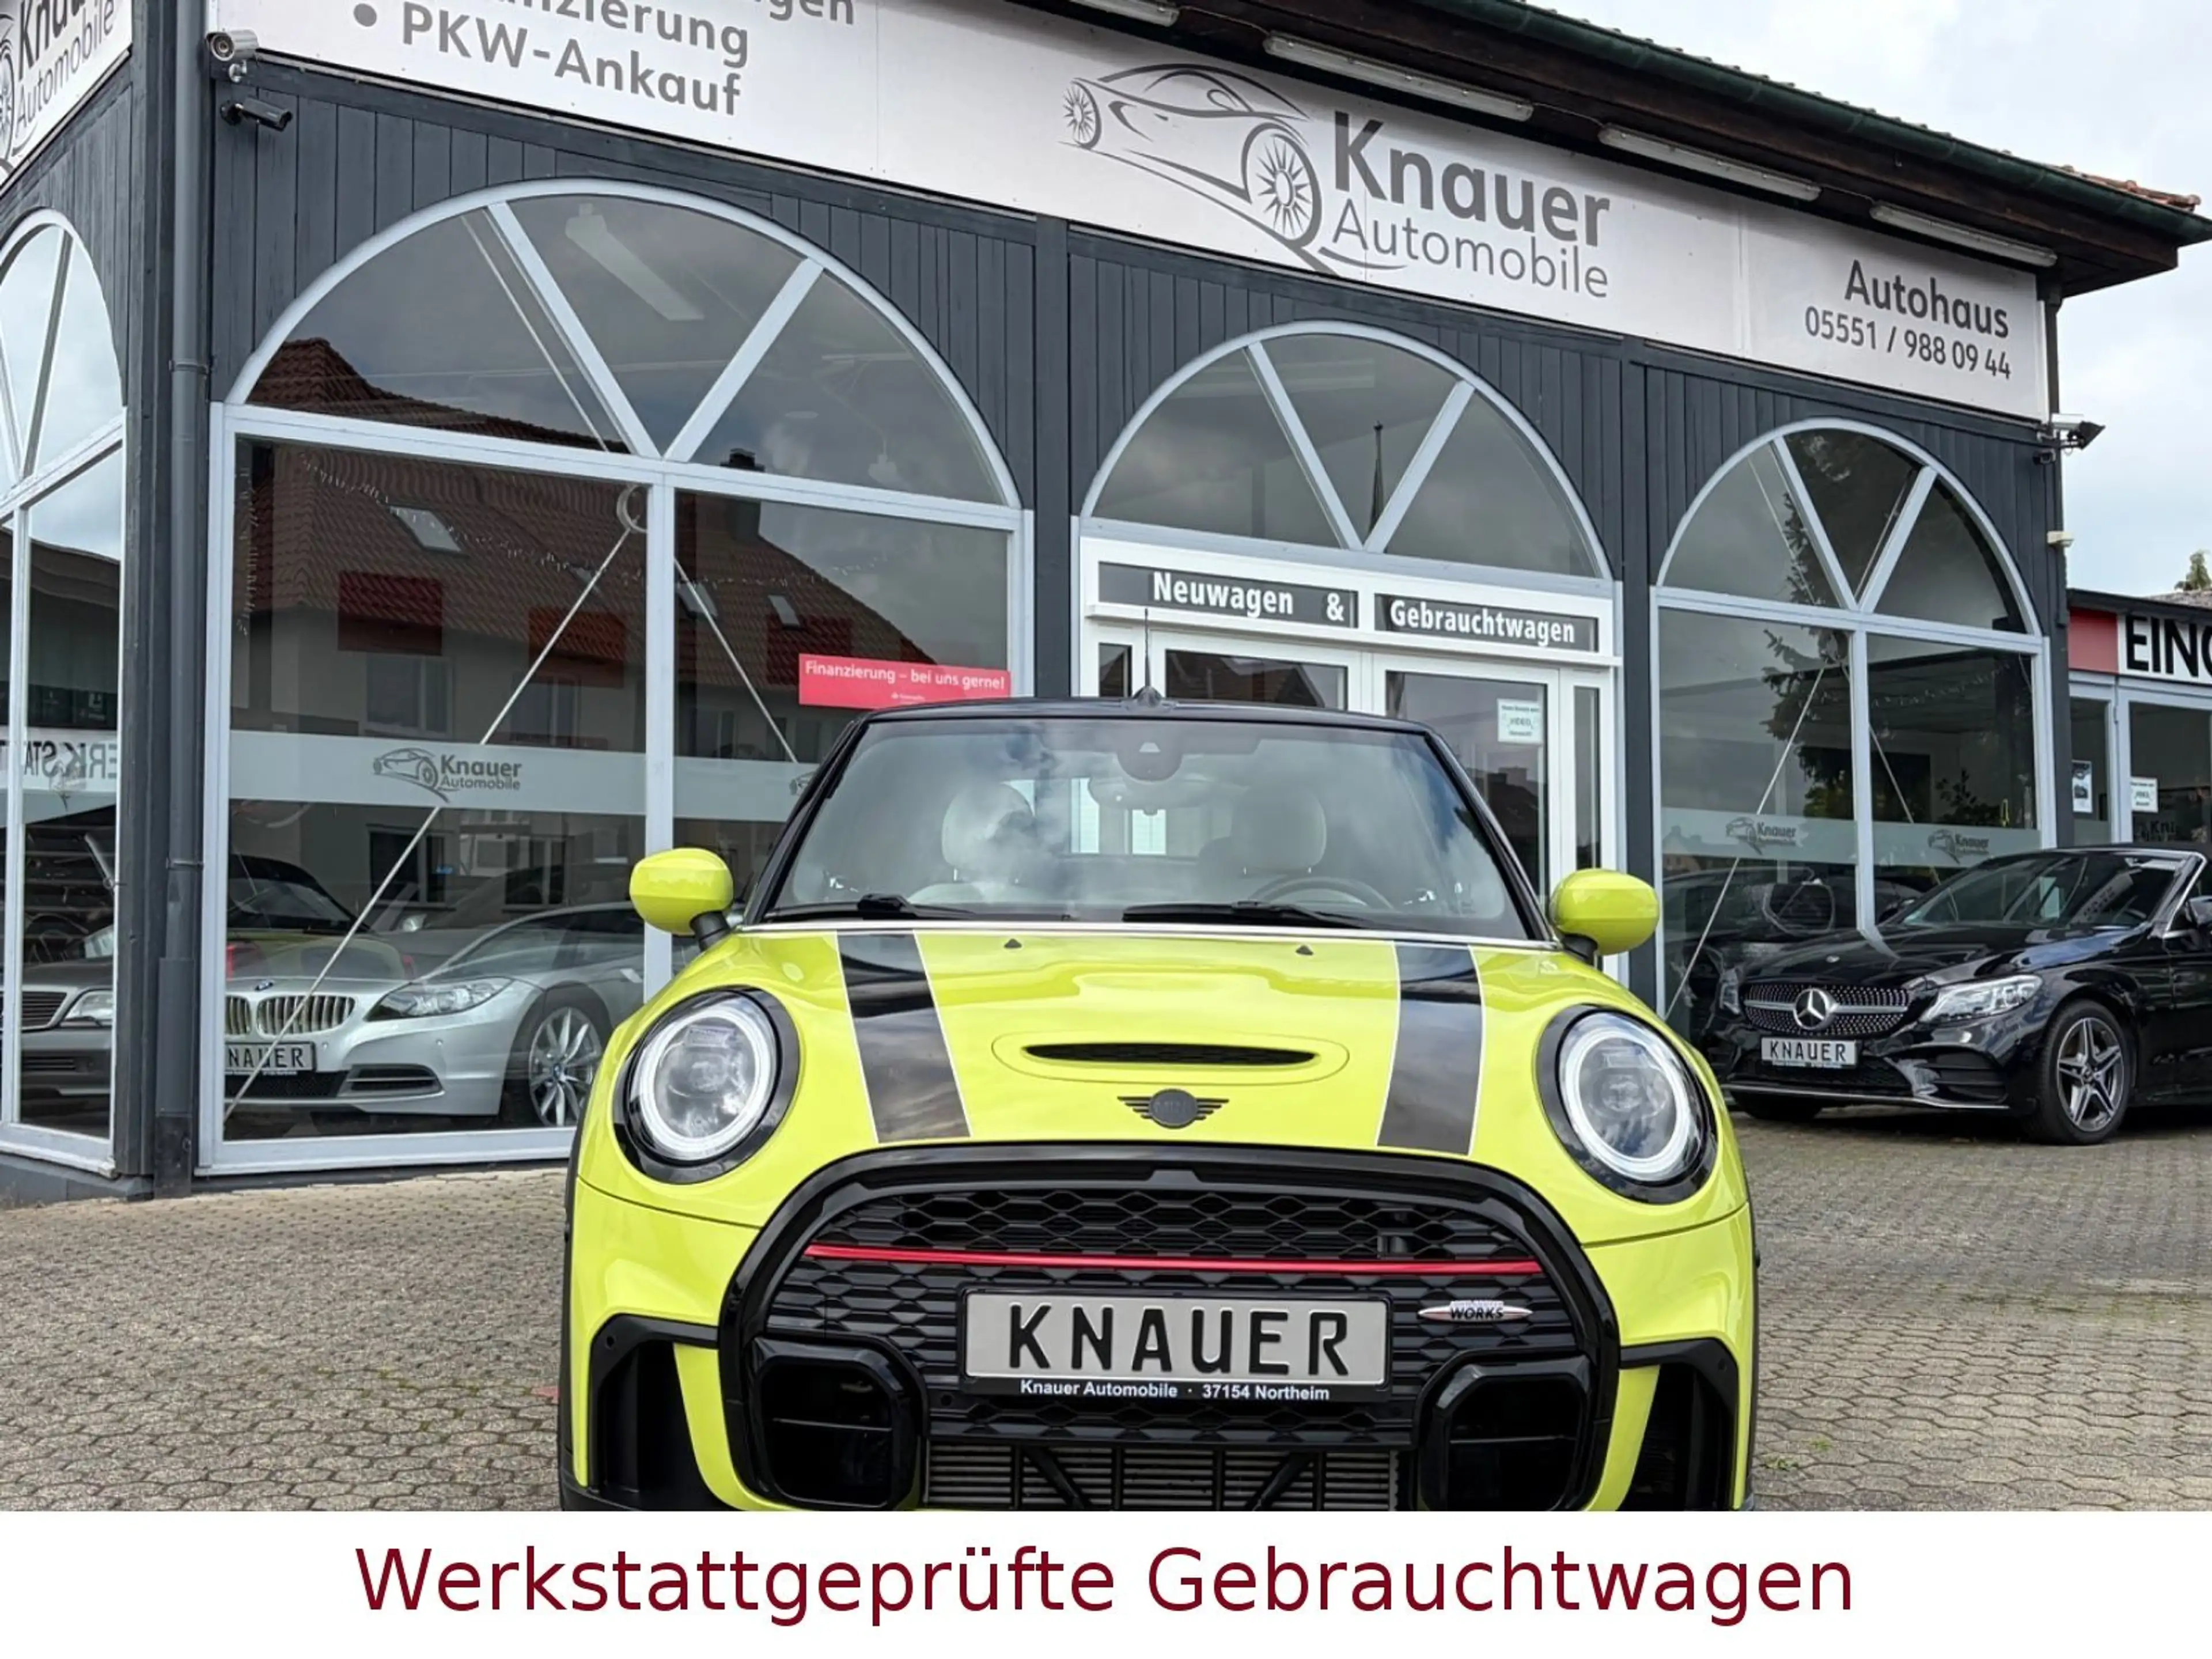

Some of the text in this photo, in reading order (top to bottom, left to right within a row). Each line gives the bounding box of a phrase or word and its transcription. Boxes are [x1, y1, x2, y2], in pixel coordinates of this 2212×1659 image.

[15, 0, 114, 139] Automobile
[403, 2, 741, 116] PKW-Ankauf
[1335, 111, 1610, 247] Knauer
[1332, 198, 1608, 298] Automobile
[1844, 259, 2009, 338] Autohaus
[1805, 306, 2011, 380] 05551 / 988 09 44
[1153, 571, 1344, 622] Neuwagen &
[1390, 600, 1575, 646] Gebrauchtwagen
[805, 660, 896, 684] Finanzierung
[911, 669, 932, 684] bei
[935, 673, 959, 685] uns
[963, 675, 1005, 691] gerne!
[440, 775, 521, 790] Automobile
[441, 754, 522, 777] Knauer
[229, 1047, 304, 1067] NAUER
[1770, 1041, 1846, 1062] KNAUER
[1450, 1306, 1503, 1319] WORKS
[1009, 1303, 1349, 1376] KNAUER
[1020, 1380, 1330, 1400] Knauer Automobile 37154 Northeim
